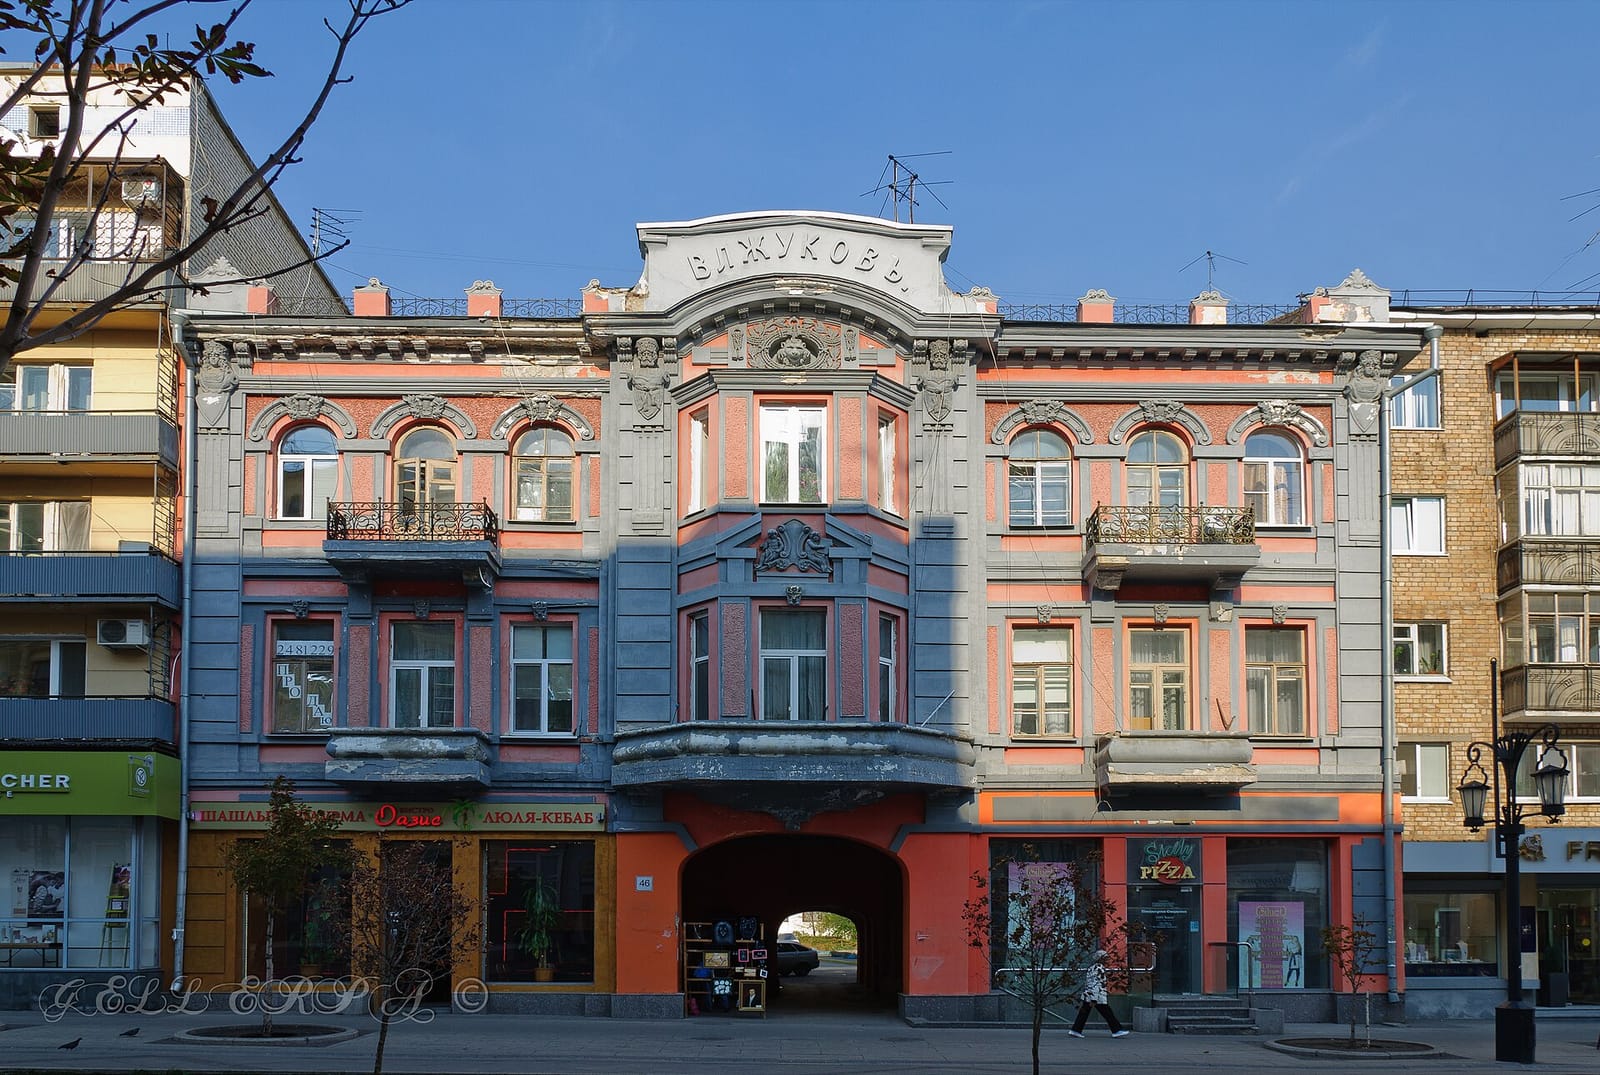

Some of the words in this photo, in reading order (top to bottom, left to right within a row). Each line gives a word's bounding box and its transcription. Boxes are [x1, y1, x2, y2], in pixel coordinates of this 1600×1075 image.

[0, 774, 70, 788] CHER
[200, 810, 281, 823] ШАШЛЫ
[482, 811, 594, 825] ЛЮЛЯ-КЕБАБ
[1140, 860, 1196, 879] PIZZA
[639, 879, 650, 887] 46
